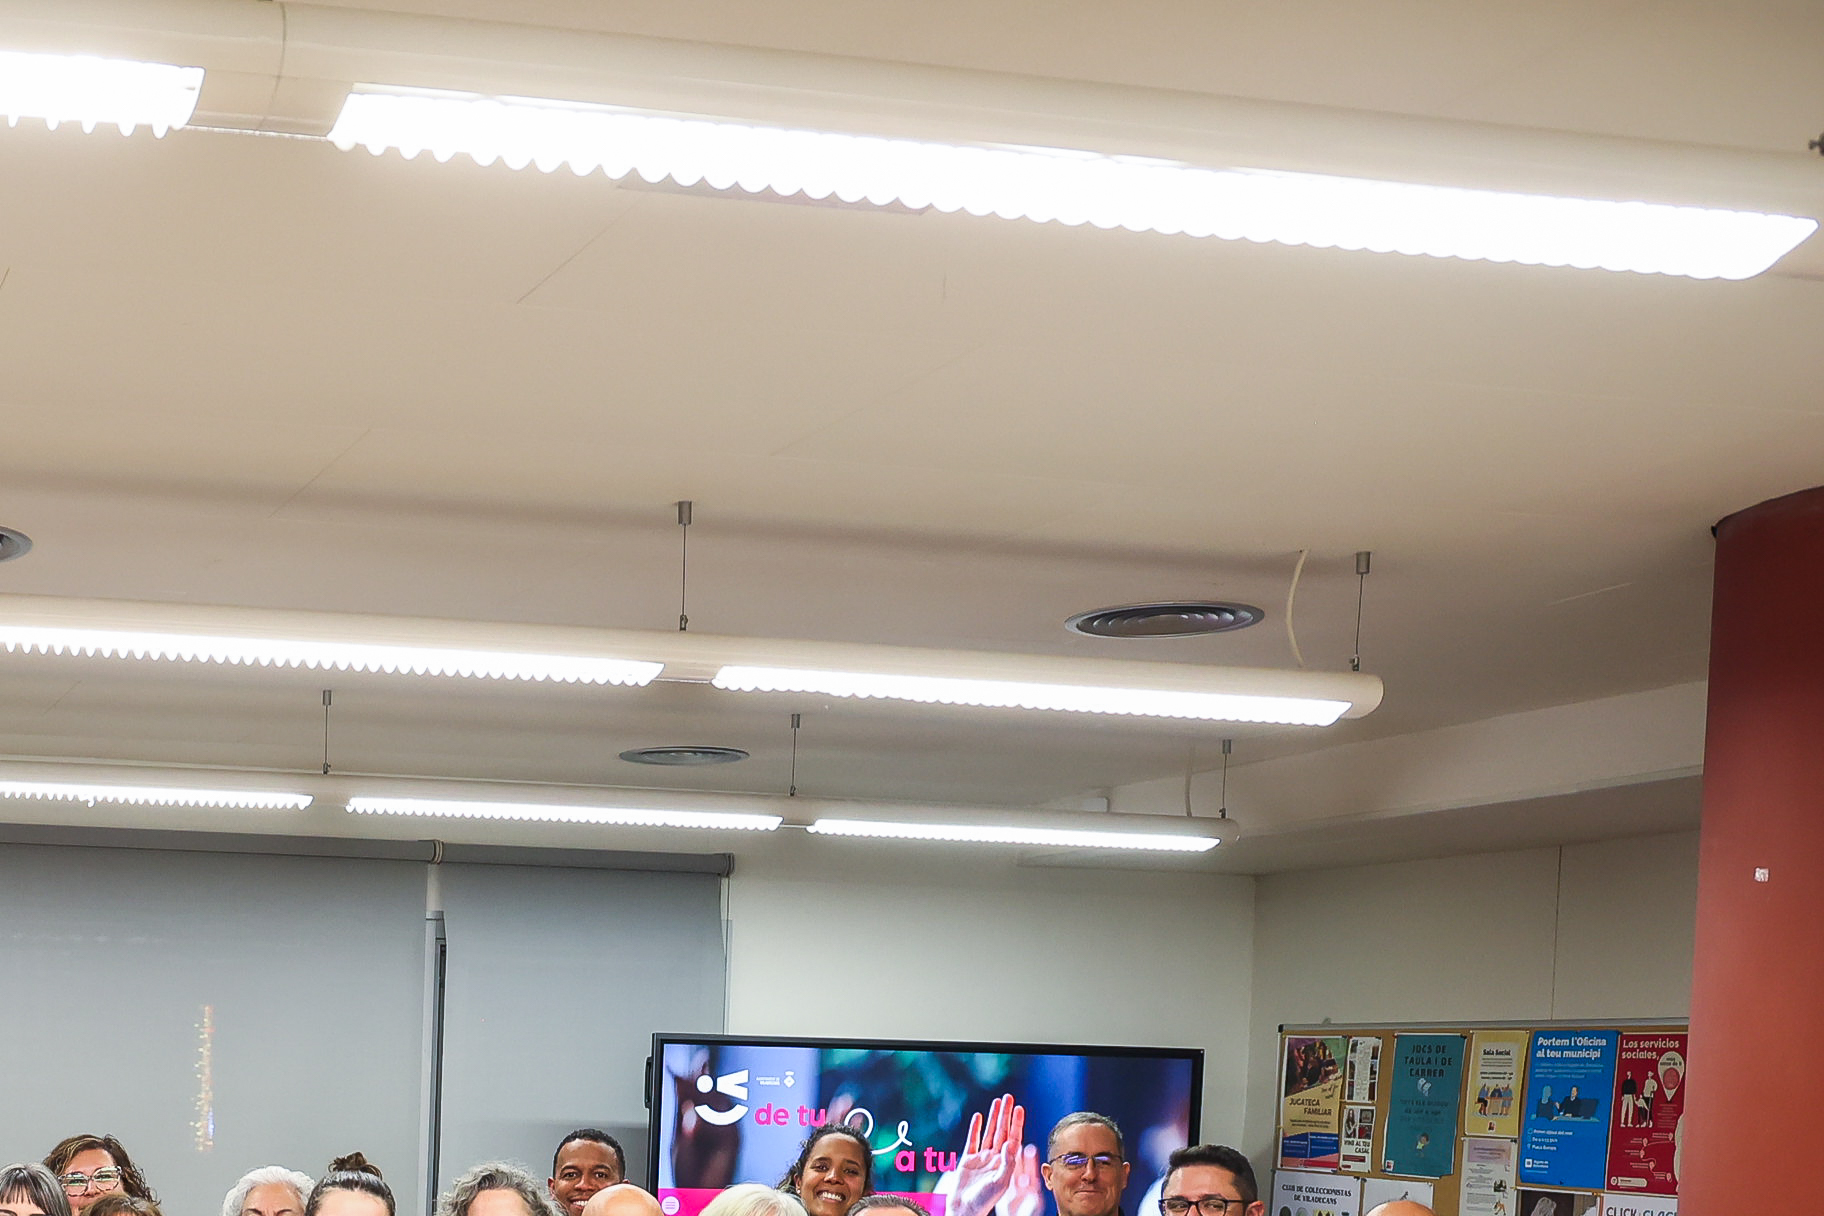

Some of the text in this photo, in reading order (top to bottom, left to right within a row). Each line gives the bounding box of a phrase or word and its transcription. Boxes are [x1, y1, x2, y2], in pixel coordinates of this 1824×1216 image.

[1537, 1036, 1607, 1046] Portem l'Oficina
[1622, 1038, 1679, 1048] Los servicios
[1411, 1044, 1446, 1053] JOCS DE
[1536, 1048, 1601, 1060] al teu municipi
[1621, 1049, 1660, 1060] sociales,
[1404, 1056, 1431, 1065] TAULA
[1440, 1057, 1452, 1066] DE
[1409, 1069, 1445, 1078] CARRER
[1289, 1098, 1321, 1106] JUCATECA
[755, 1103, 826, 1127] de tu
[1303, 1108, 1332, 1116] FAMILIAR
[894, 1146, 957, 1172] a tu
[1296, 1185, 1304, 1193] DE
[1304, 1186, 1352, 1197] COLECCIONISTAS
[1293, 1194, 1302, 1202] DE
